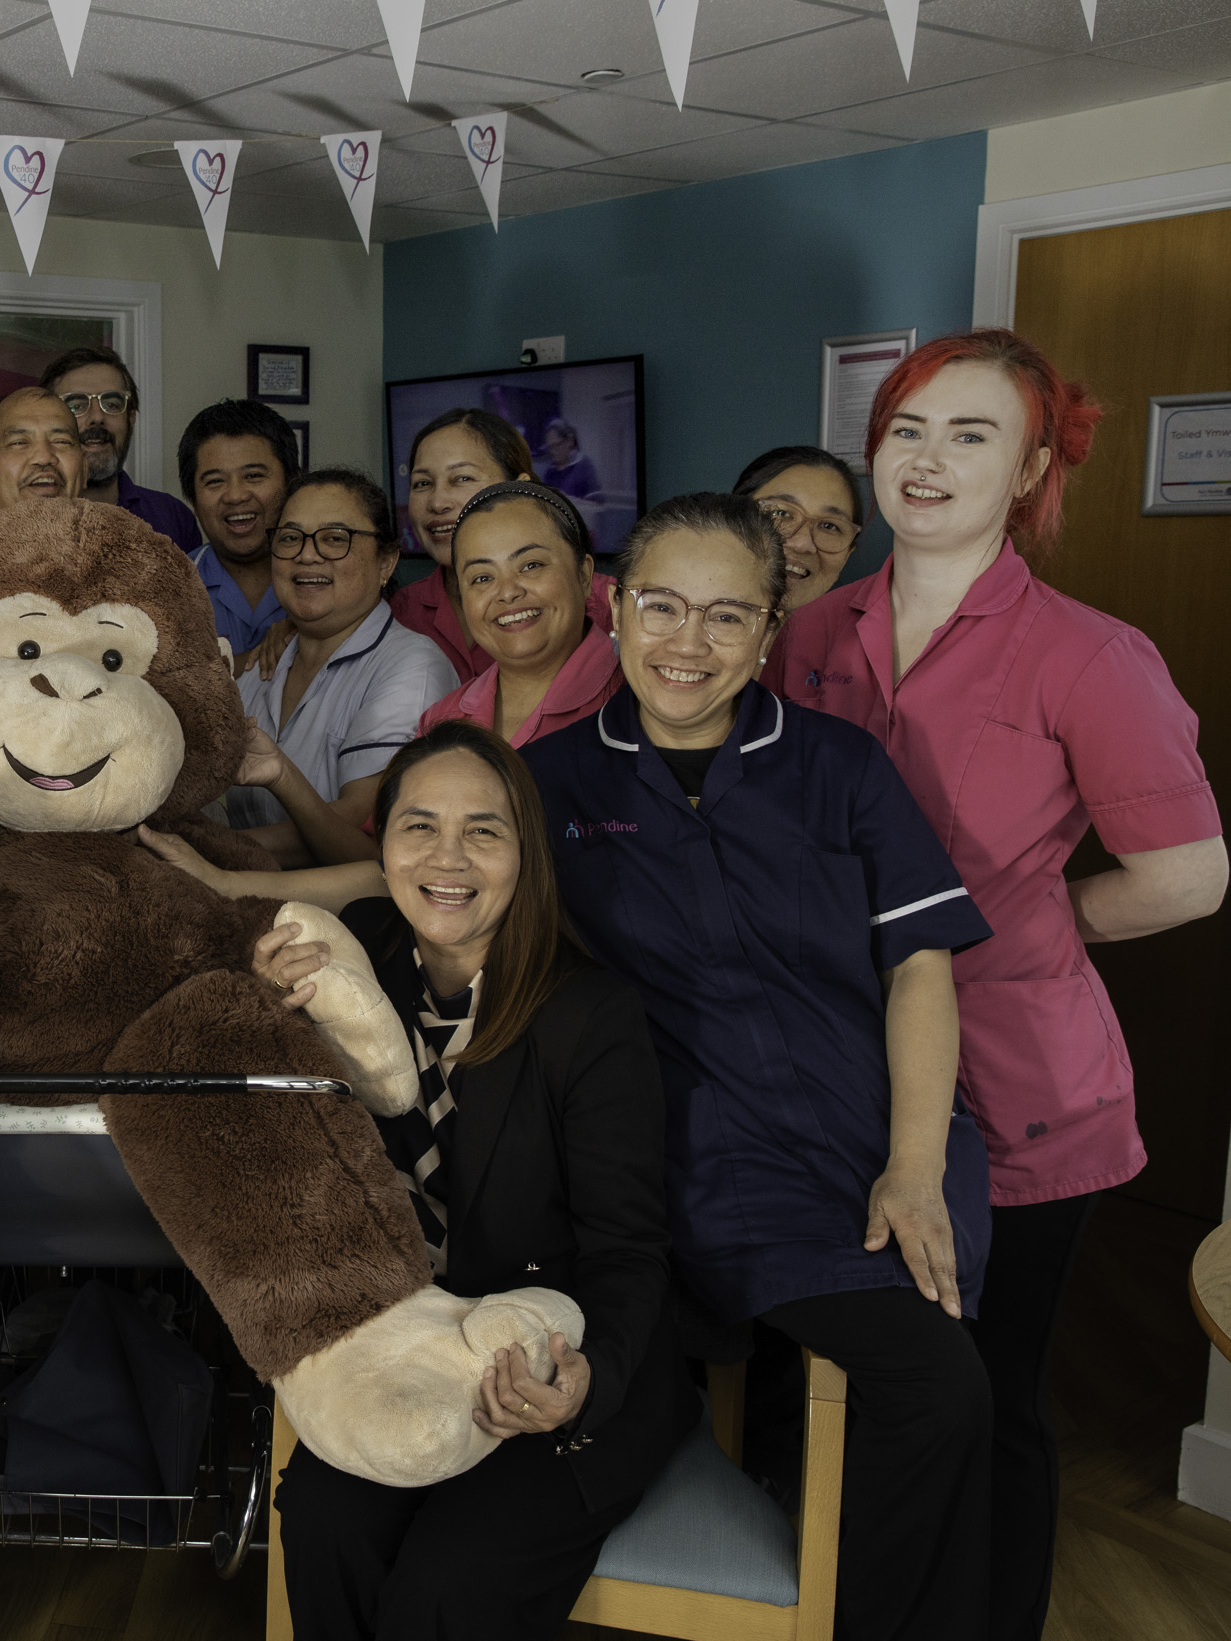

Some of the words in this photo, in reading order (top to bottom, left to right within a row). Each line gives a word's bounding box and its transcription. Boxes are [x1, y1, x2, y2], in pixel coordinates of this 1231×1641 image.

[12, 165, 38, 174] Pendine
[20, 173, 35, 184] 40
[1178, 450, 1202, 460] Staff
